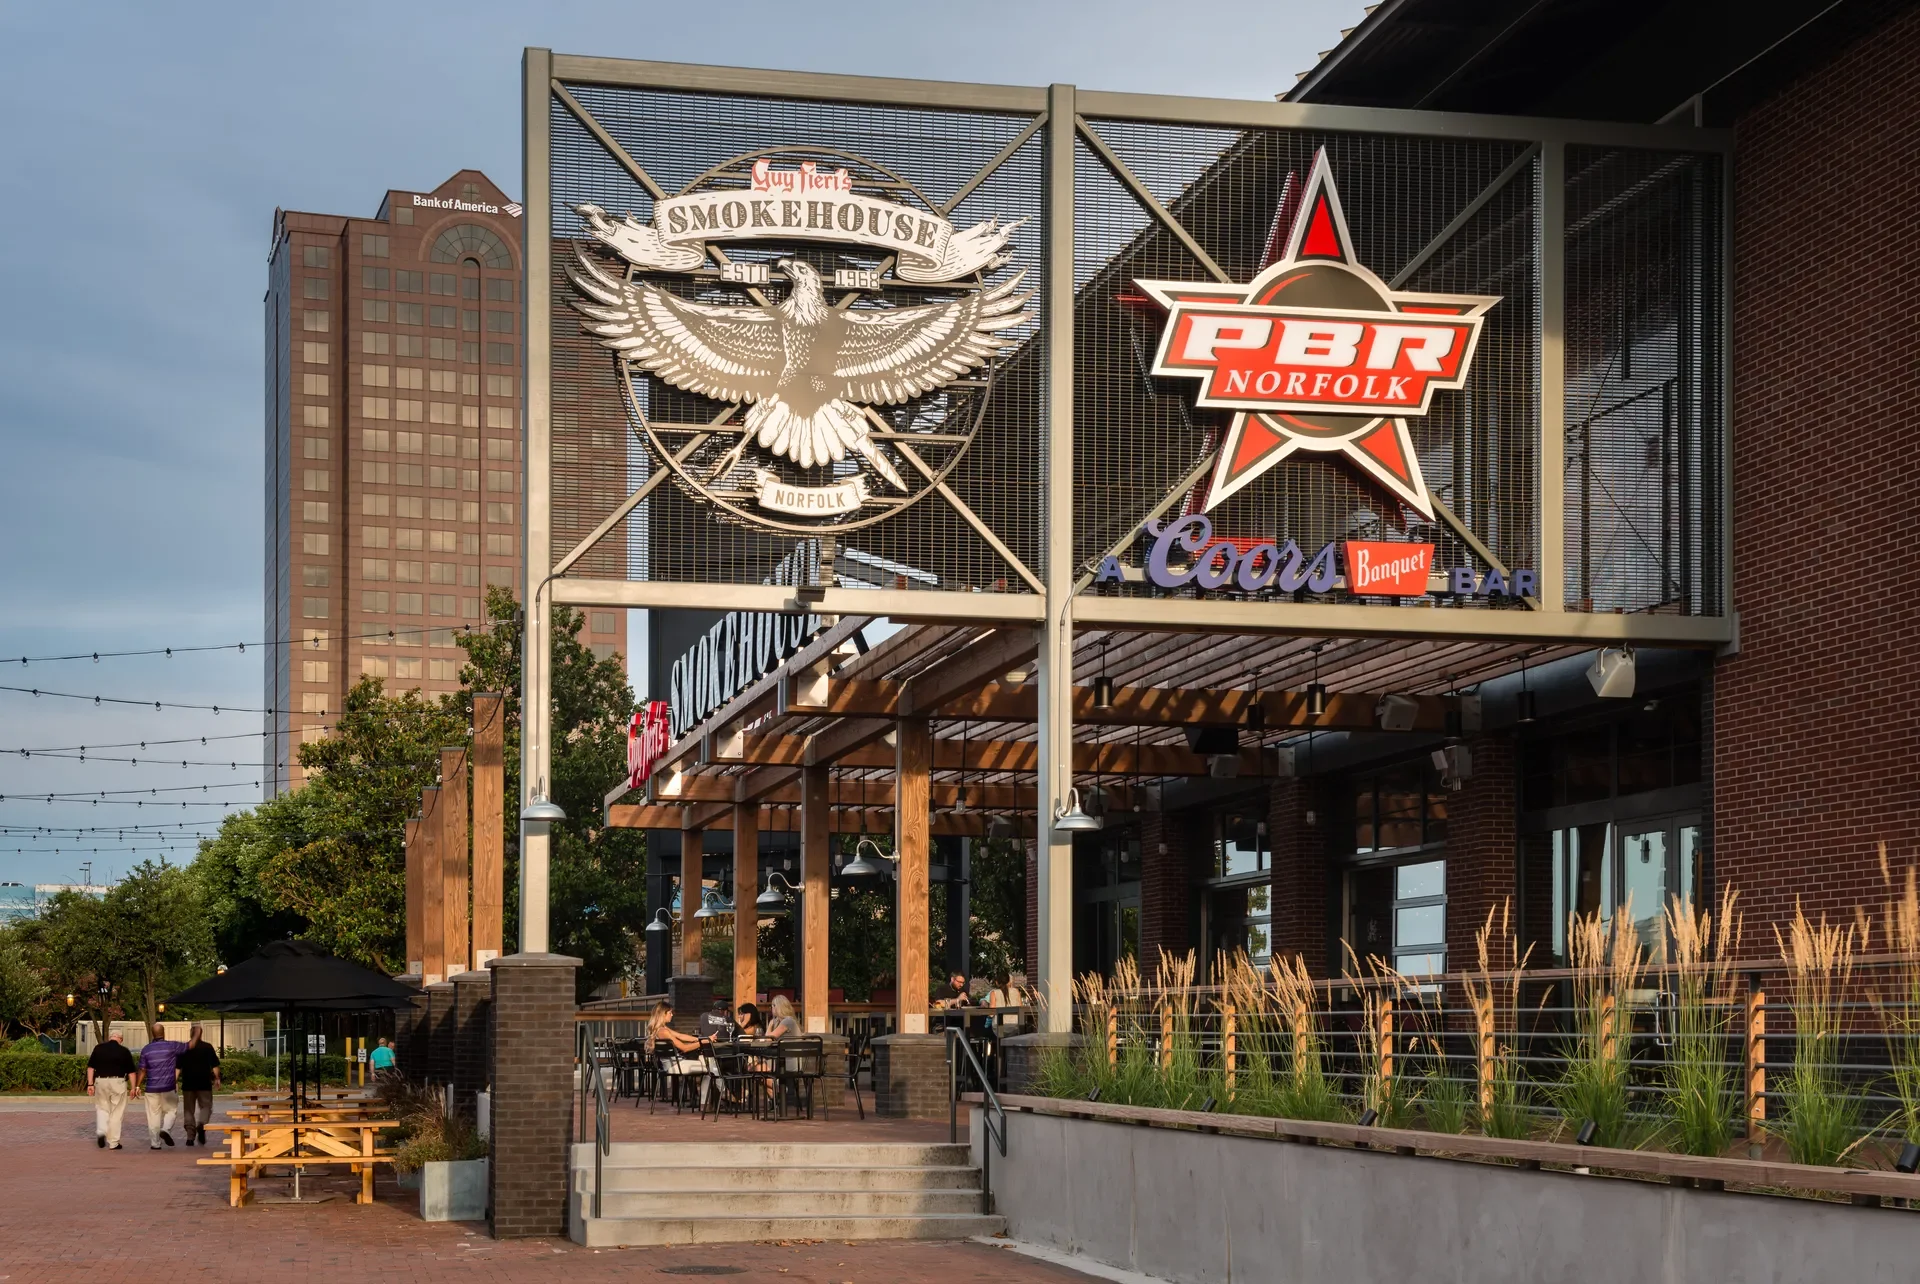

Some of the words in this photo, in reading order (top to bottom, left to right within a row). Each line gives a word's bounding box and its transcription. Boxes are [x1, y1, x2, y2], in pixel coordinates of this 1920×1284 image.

[752, 158, 794, 192] Guy
[413, 195, 441, 207] Bank
[442, 198, 453, 209] of
[453, 199, 498, 214] America
[668, 199, 939, 249] SMOKEHOUSE
[721, 262, 769, 283] ESTD
[836, 270, 879, 288] 1968
[1182, 315, 1456, 372] PBR
[1224, 369, 1412, 400] NORFOLK
[775, 489, 846, 509] NORFOLK
[1096, 554, 1125, 583] A
[1148, 514, 1342, 593] Coors
[1357, 549, 1426, 588] Banquet
[1451, 567, 1537, 597] BAR
